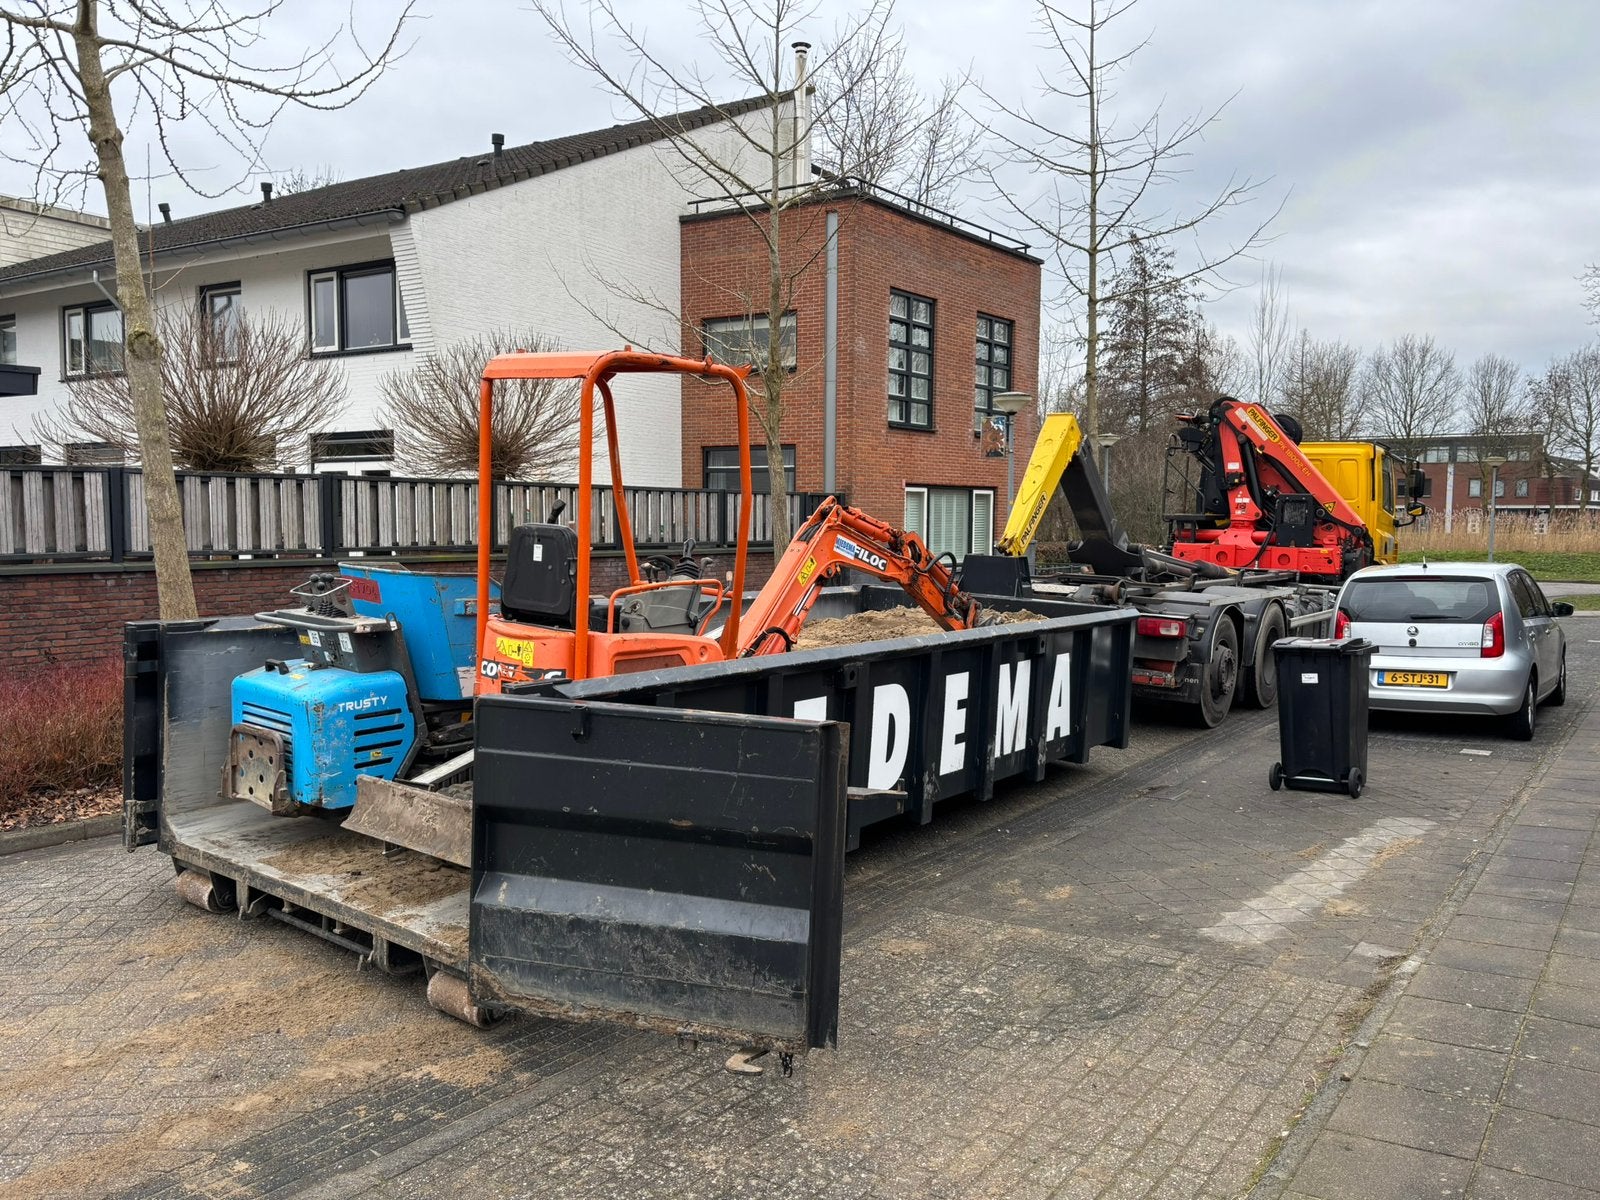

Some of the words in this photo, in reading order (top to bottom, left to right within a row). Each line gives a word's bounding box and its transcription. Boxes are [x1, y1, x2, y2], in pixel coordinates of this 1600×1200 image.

[1248, 408, 1278, 441] PALFINGER
[1021, 494, 1046, 545] PALFINGER
[338, 695, 388, 713] TRUSTY
[794, 653, 1070, 790] DEMA
